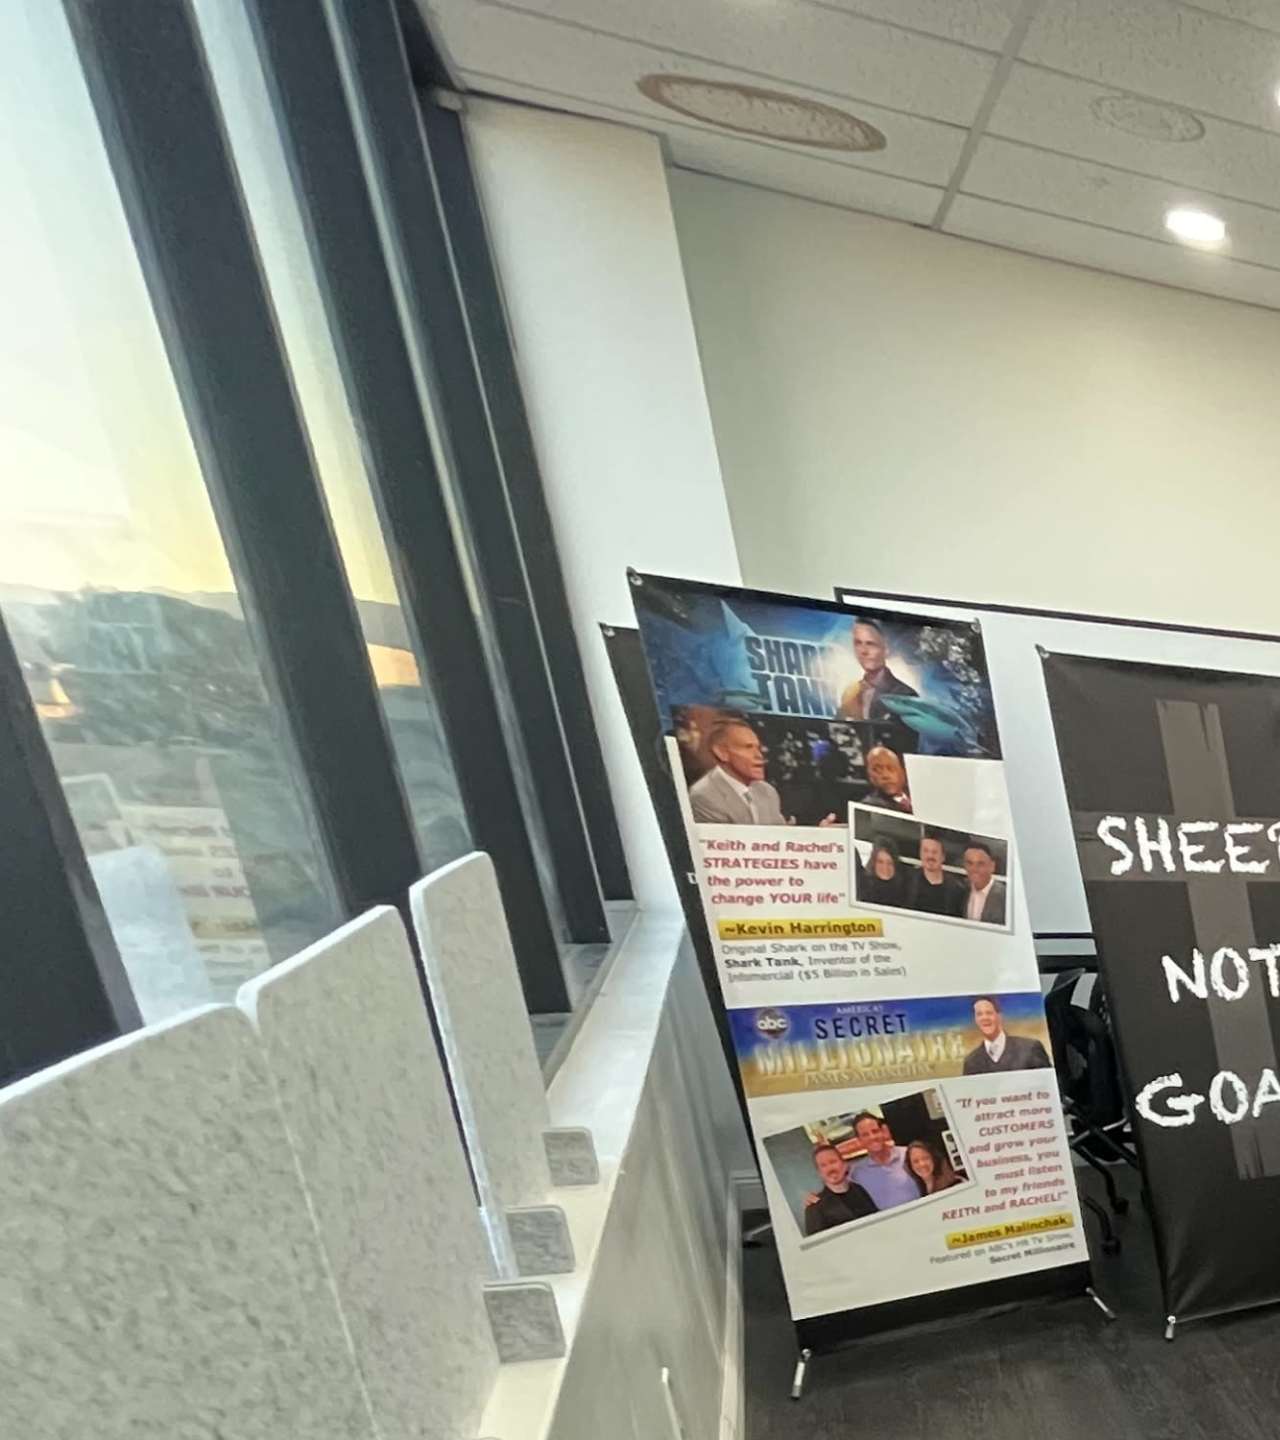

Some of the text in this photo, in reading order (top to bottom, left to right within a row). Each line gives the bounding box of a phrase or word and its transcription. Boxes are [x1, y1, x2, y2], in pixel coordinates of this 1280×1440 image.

[744, 635, 834, 680] SHAR
[699, 839, 845, 853] "Keith and Rachel's
[703, 857, 838, 870] STRATEGIES have
[707, 875, 731, 887] the
[735, 877, 784, 888] power
[789, 876, 804, 887] to
[711, 892, 764, 906] change
[770, 892, 812, 904] YOUR
[790, 921, 876, 936] Harrington
[771, 943, 807, 954] Shark
[811, 944, 826, 953] on
[829, 942, 848, 952] the
[851, 941, 866, 951] TV
[724, 957, 761, 969] Shark
[808, 956, 856, 967] Inventor
[860, 954, 870, 965] of
[873, 953, 891, 964] the
[860, 967, 871, 977] in
[757, 1015, 788, 1030] abc
[815, 1013, 907, 1039] SECRET
[755, 1033, 966, 1075] MILLIONAIRE
[975, 1097, 997, 1107] you
[1001, 1092, 1032, 1103] want
[1037, 1090, 1050, 1100] to
[974, 1106, 1052, 1122] attract more
[979, 1119, 1055, 1137] CUSTOMERS
[968, 1136, 1058, 1154] and grow your
[1037, 1150, 1060, 1161] you
[994, 1164, 1063, 1180] must listen
[985, 1178, 1065, 1198] to my friends
[942, 1206, 980, 1220] KEITH
[984, 1201, 1006, 1213] and
[1005, 1215, 1068, 1234] Malinchak
[989, 1251, 1022, 1264] Secret
